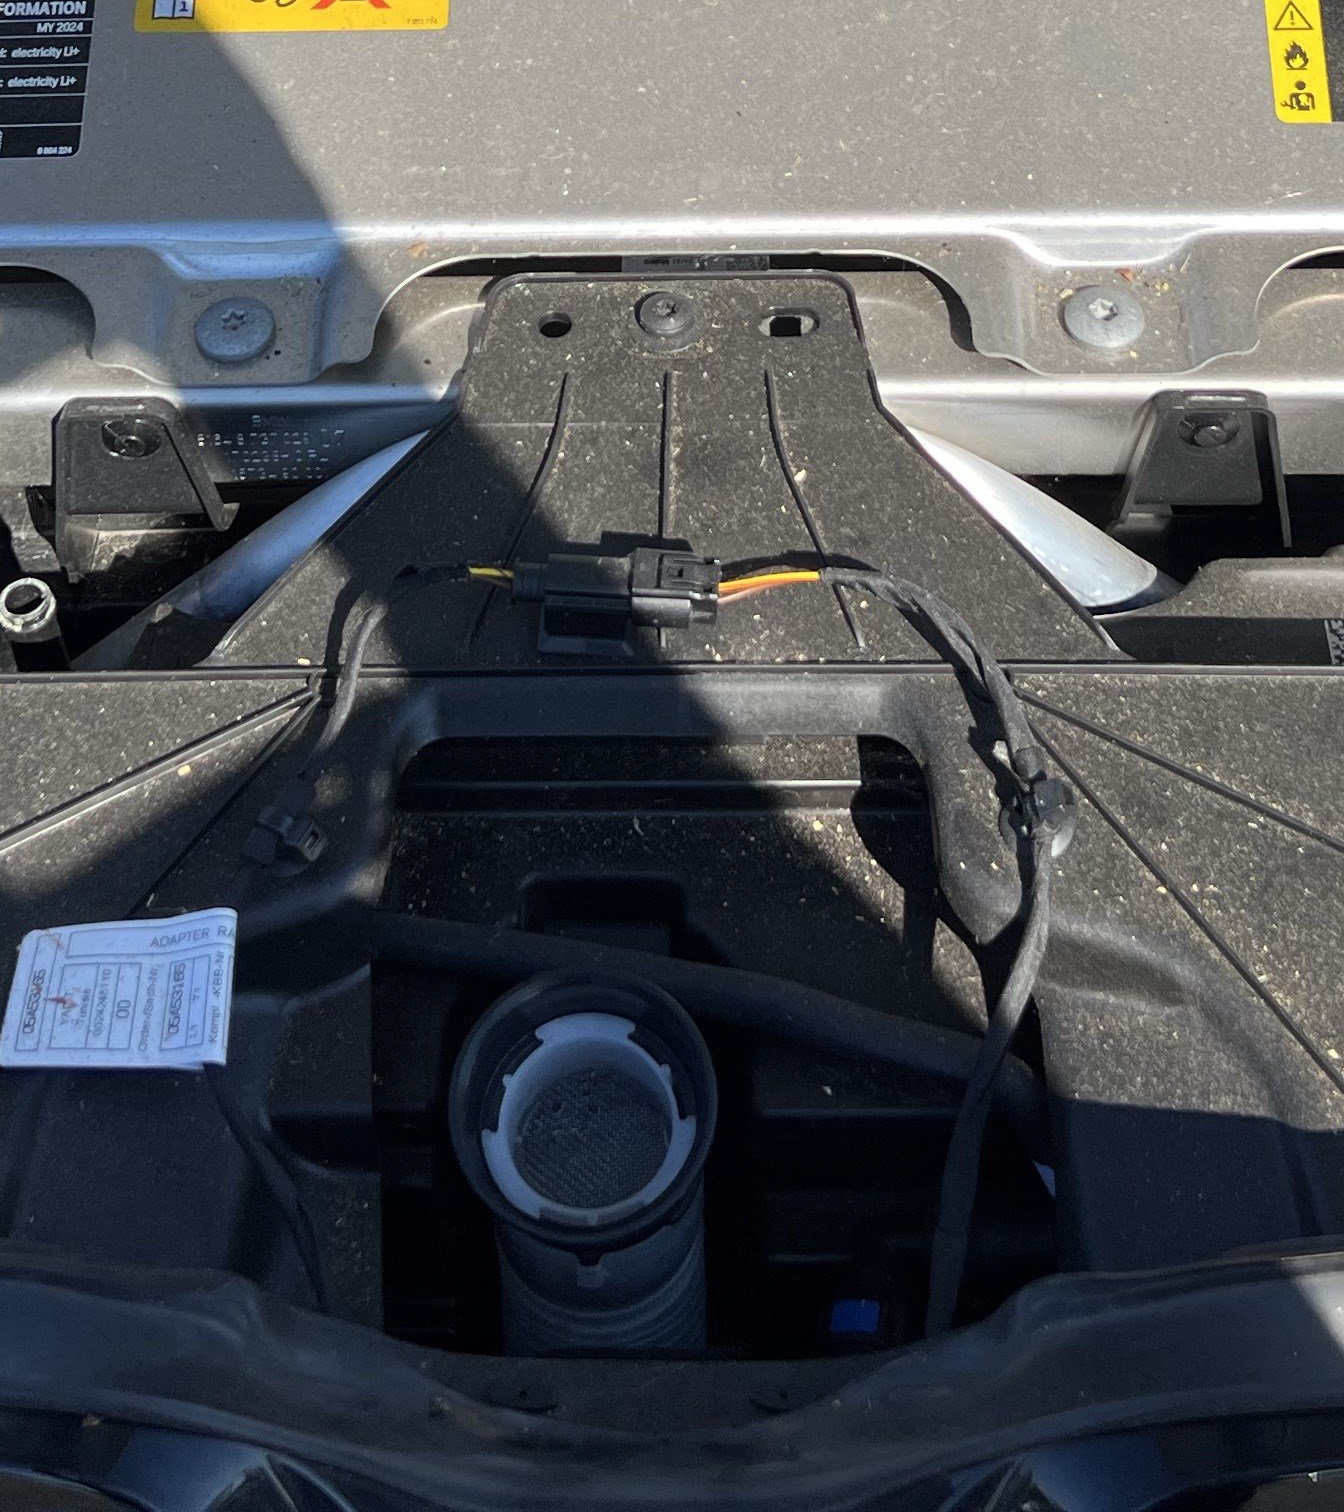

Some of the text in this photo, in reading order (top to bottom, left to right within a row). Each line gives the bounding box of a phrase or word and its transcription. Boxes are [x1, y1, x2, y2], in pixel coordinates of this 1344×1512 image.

[36, 21, 84, 33] MY 2024
[11, 47, 62, 59] electricity
[7, 76, 59, 89] electricity
[149, 925, 209, 949] ADAPTER
